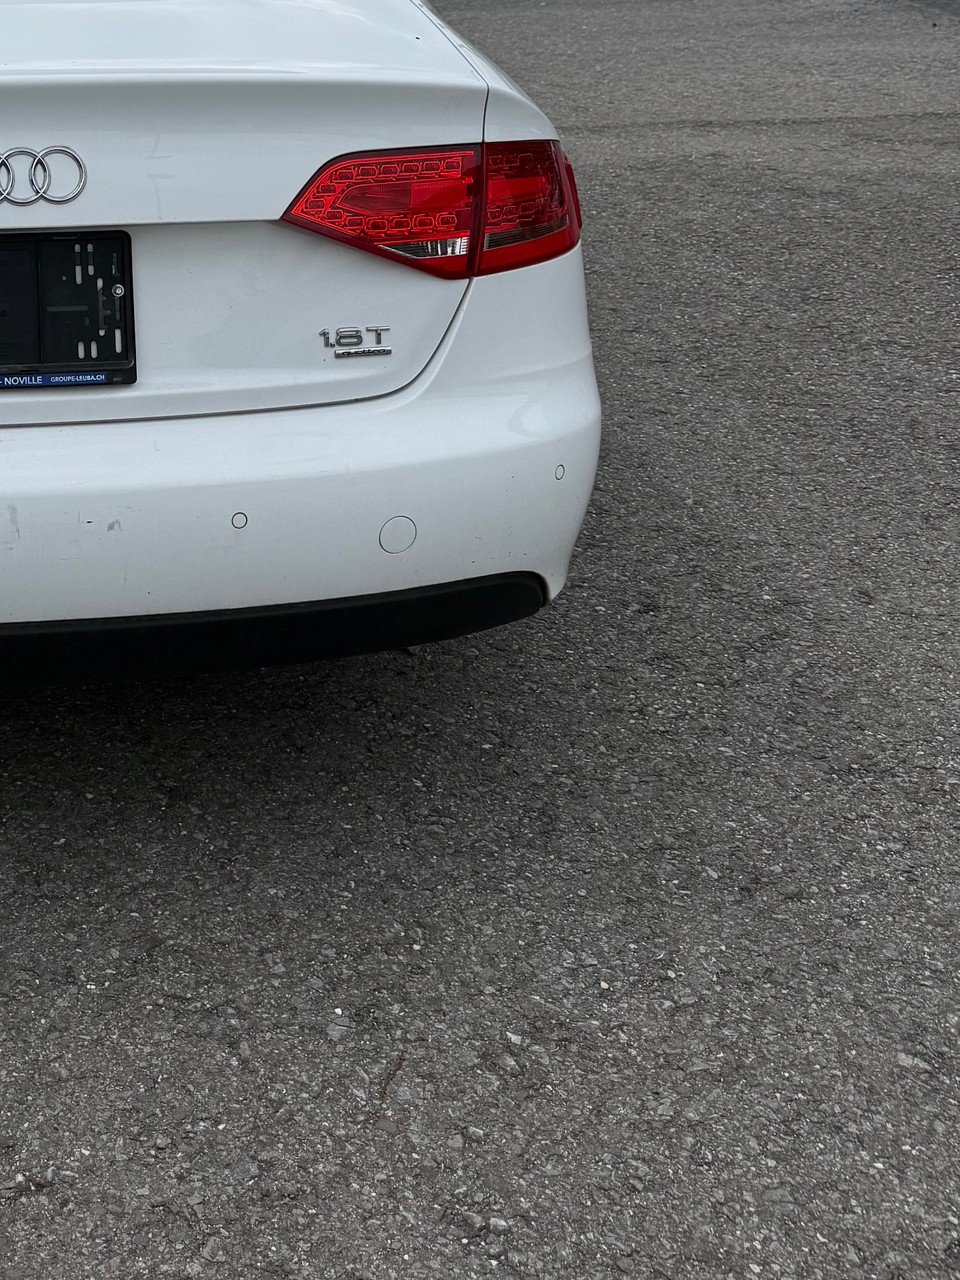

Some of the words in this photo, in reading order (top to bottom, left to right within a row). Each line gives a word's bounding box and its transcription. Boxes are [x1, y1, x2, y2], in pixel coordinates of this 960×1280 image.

[319, 326, 390, 348] 1.8T
[4, 376, 42, 385] NOVILLE
[50, 374, 105, 382] GROUPE-LEUBA.CH
